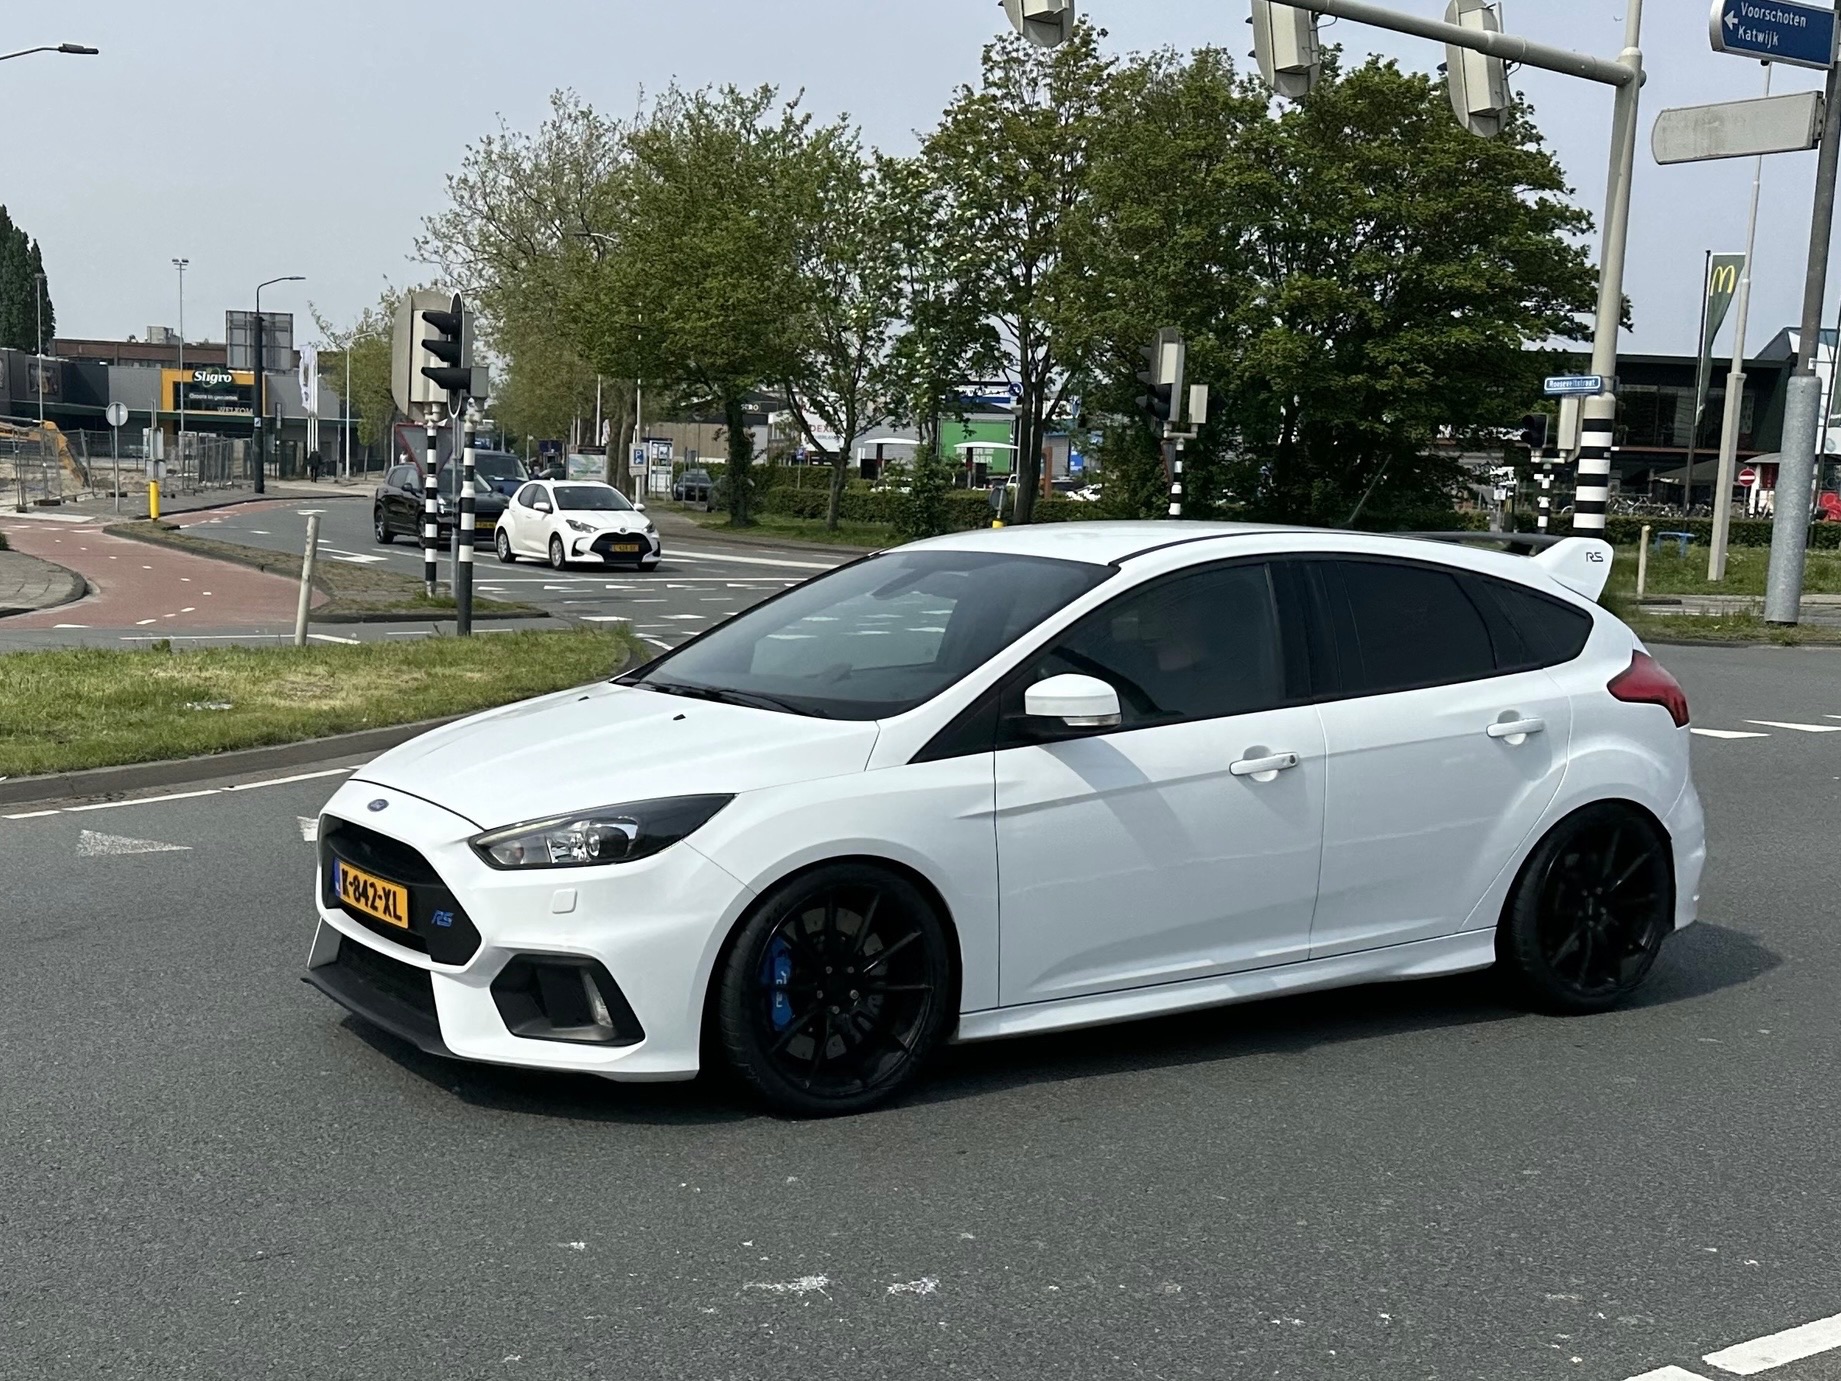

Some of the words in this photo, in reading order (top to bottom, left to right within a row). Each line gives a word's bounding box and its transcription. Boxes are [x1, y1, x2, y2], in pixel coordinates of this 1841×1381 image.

[1740, 2, 1806, 28] Voorschoten
[1738, 25, 1779, 48] Katwijk
[193, 370, 232, 384] Sligro
[1586, 551, 1604, 562] RS
[341, 867, 403, 922] K-842-XL
[431, 910, 454, 927] RS
